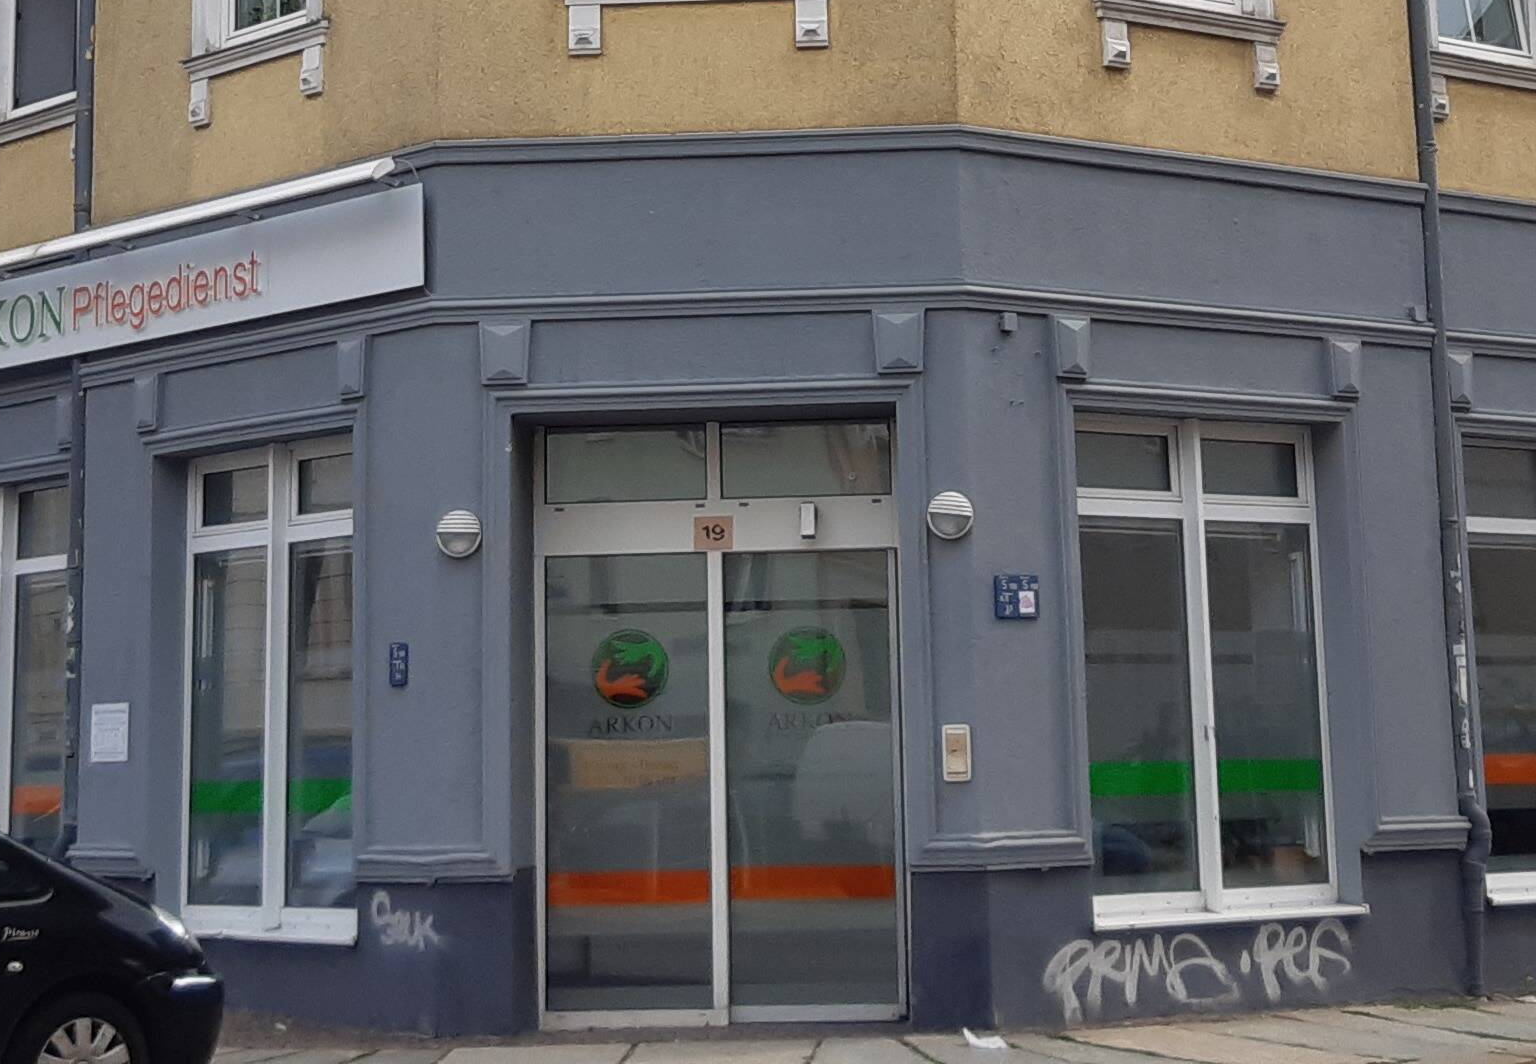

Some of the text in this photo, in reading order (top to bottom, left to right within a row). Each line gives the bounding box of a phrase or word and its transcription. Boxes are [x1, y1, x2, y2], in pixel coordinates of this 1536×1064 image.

[72, 250, 261, 330] Pflegedienst
[702, 524, 725, 541] 19
[590, 713, 672, 735] ARKON
